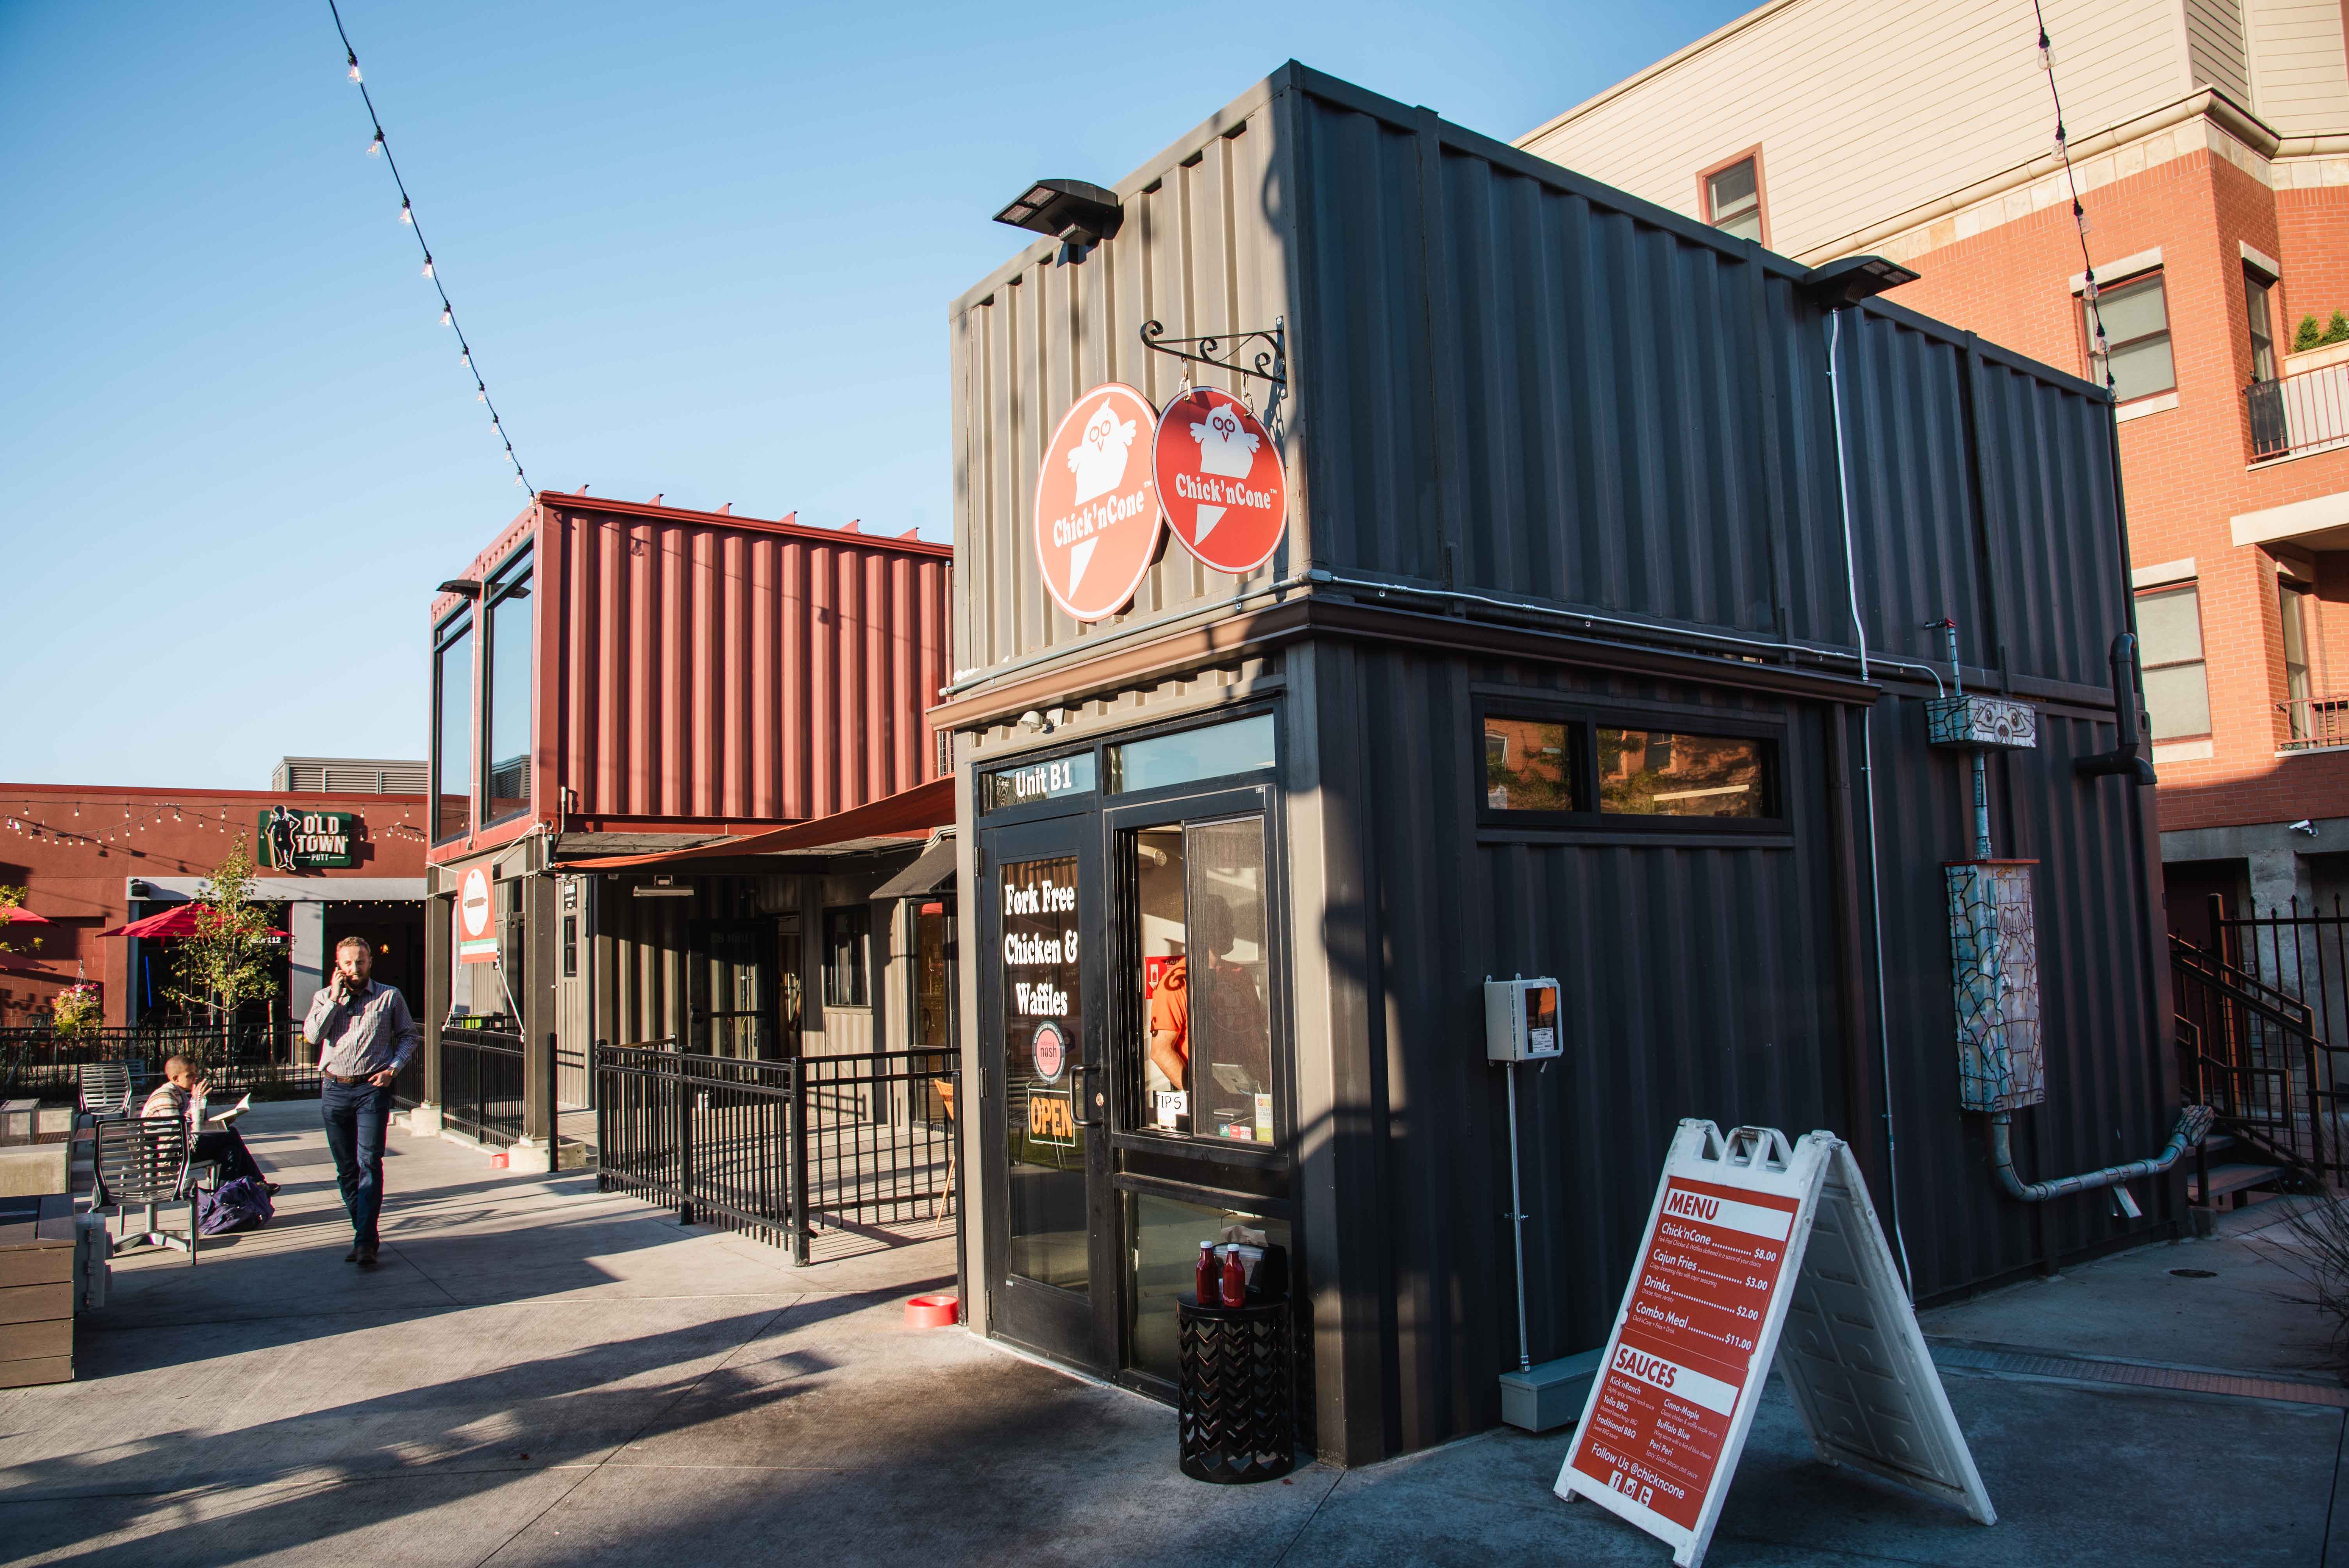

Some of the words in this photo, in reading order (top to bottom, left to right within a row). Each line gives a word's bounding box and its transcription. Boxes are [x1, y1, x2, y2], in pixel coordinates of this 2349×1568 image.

[1176, 473, 1271, 509] Chick'nCone
[1053, 490, 1144, 547] Chick'nCone
[1016, 768, 1047, 797] Unit
[1050, 761, 1072, 791] B1
[303, 816, 339, 834] OLD
[295, 835, 346, 854] TOWN
[1005, 881, 1039, 916] Fork
[1042, 880, 1075, 913] Free
[1005, 932, 1062, 965] Chicken
[1064, 930, 1078, 963] &
[1016, 983, 1068, 1016] Waffles
[1040, 1042, 1057, 1058] nosh
[1031, 1097, 1072, 1137] OPEN
[1155, 1095, 1181, 1109] TIPS
[1668, 1193, 1720, 1221] MENU
[1661, 1222, 1711, 1245] Chick'nCone
[1754, 1247, 1777, 1262] $8.00
[1653, 1249, 1677, 1267] Cajun
[1677, 1255, 1697, 1271] Fries
[1745, 1276, 1768, 1290] $3.00
[1641, 1288, 1654, 1296] Choose
[1644, 1274, 1671, 1293] Drinks
[1736, 1305, 1759, 1320] $2.00
[1636, 1301, 1664, 1320] Combo
[1665, 1311, 1689, 1329] Meal
[1725, 1333, 1752, 1350] $11.00
[1616, 1349, 1678, 1388] SAUCES
[1609, 1376, 1641, 1395] Kick'nRanch
[1604, 1394, 1616, 1406] Yella
[1616, 1400, 1629, 1412] BBQ
[1664, 1399, 1700, 1420] Cinna-Maple
[1596, 1413, 1624, 1433] Traditional
[1623, 1426, 1636, 1439] BBQ
[1656, 1418, 1677, 1434] Buffalo
[1677, 1428, 1690, 1440] Blue
[1649, 1439, 1662, 1451] Peri
[1661, 1444, 1674, 1456] Peri
[1591, 1443, 1617, 1464] Follow
[1618, 1455, 1629, 1470] Us
[1630, 1463, 1684, 1499] @chickncone
